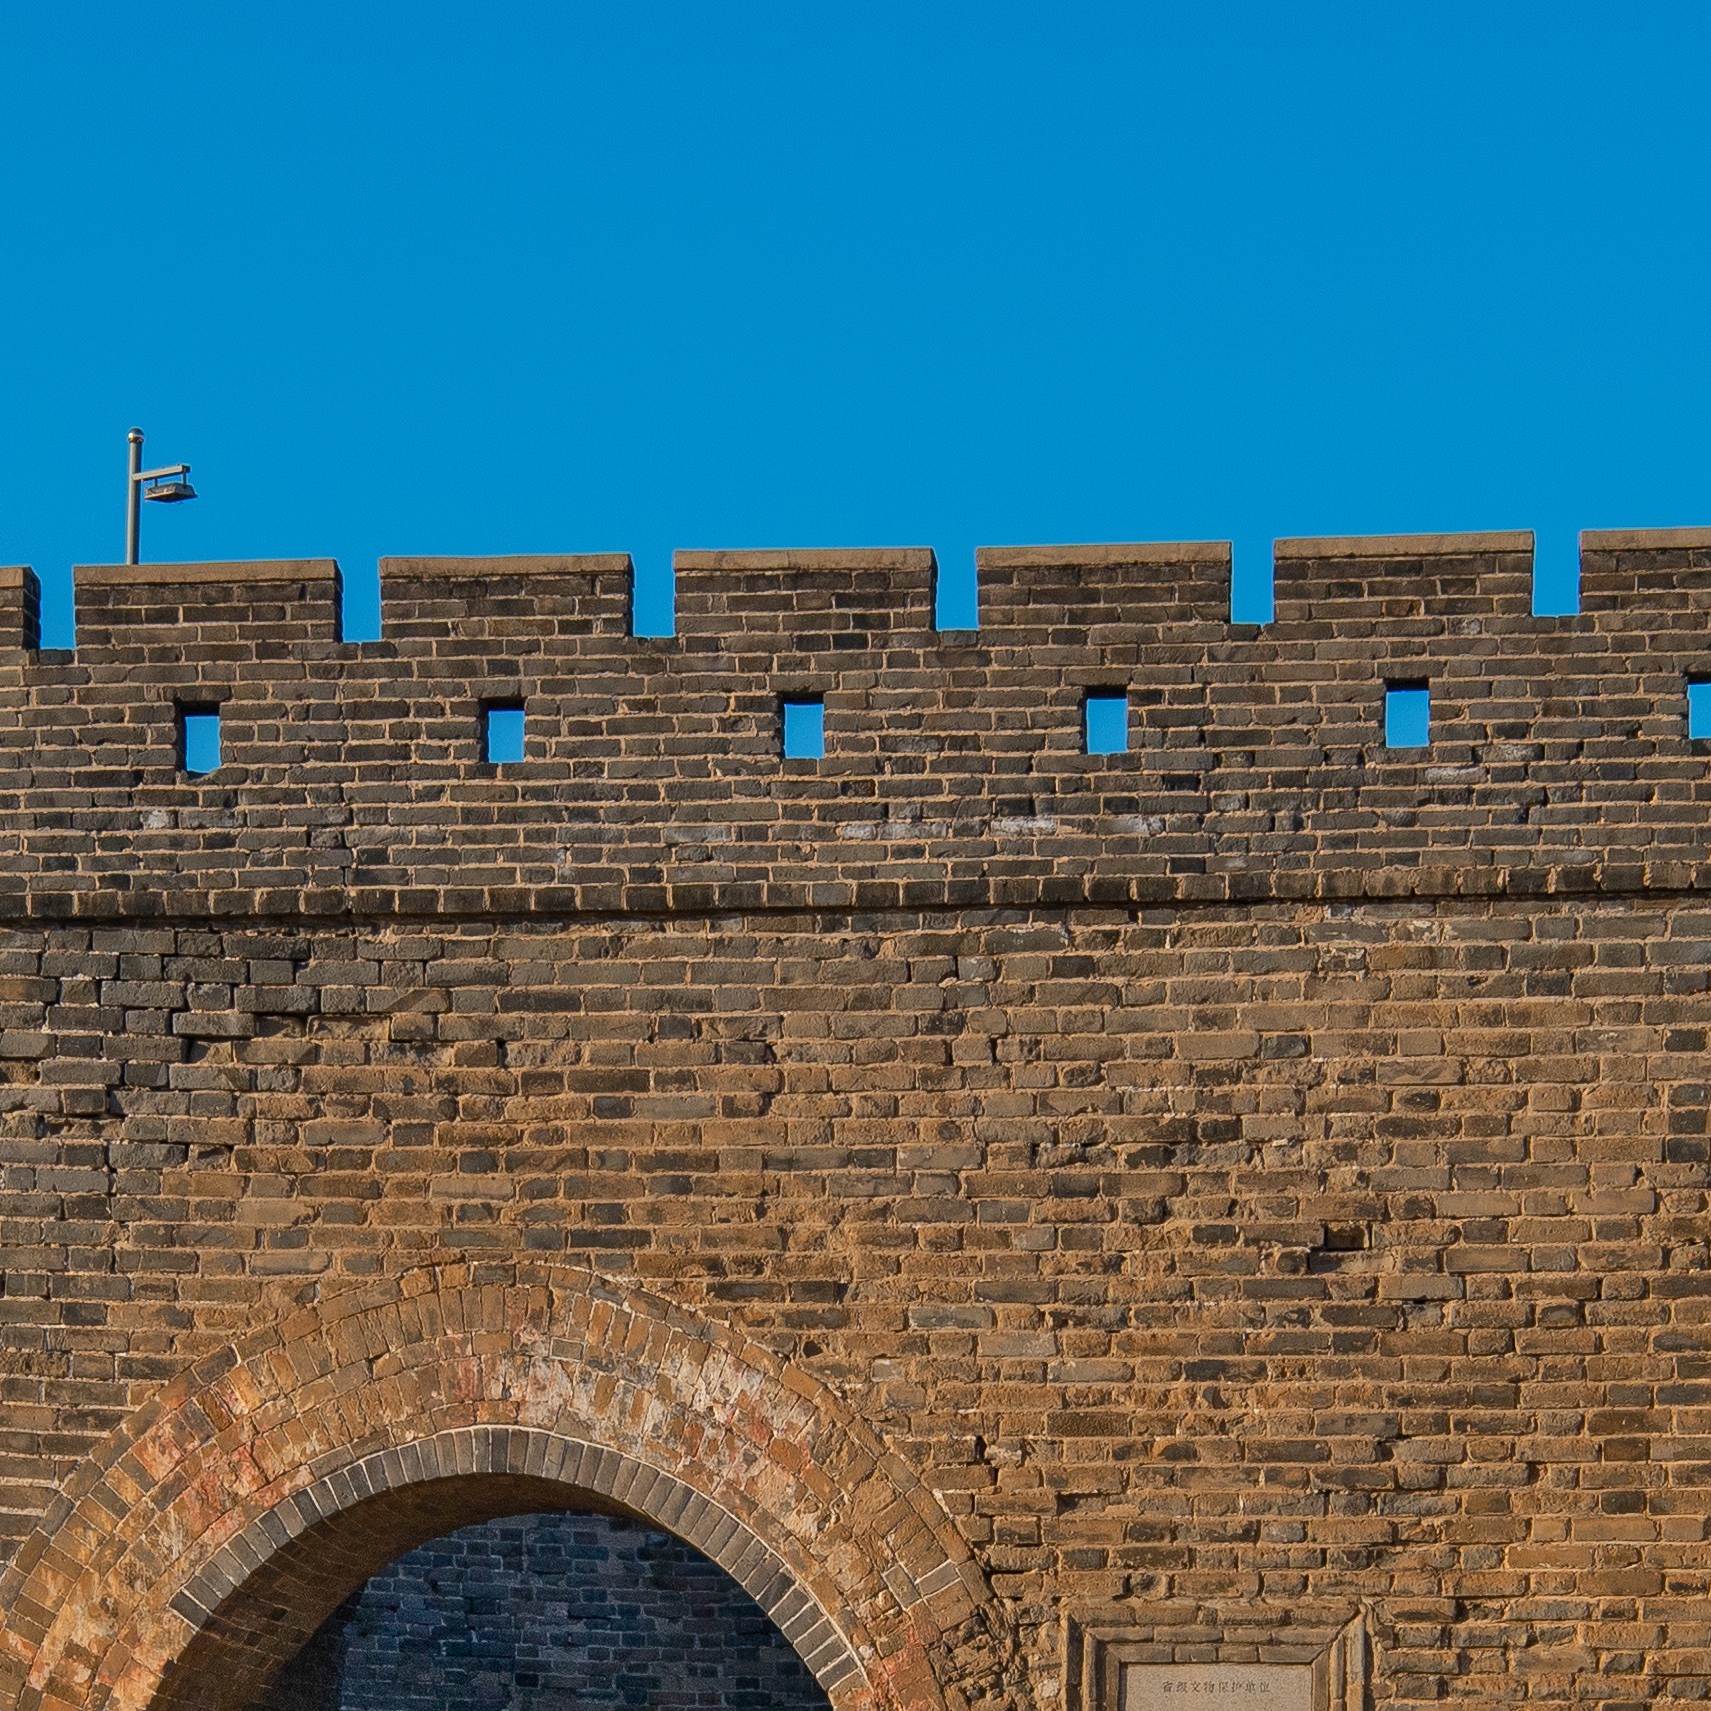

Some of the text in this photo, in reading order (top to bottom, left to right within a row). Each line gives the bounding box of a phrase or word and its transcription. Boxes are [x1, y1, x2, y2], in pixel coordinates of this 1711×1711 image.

[1162, 1680, 1270, 1693] 省级文物保护单位
